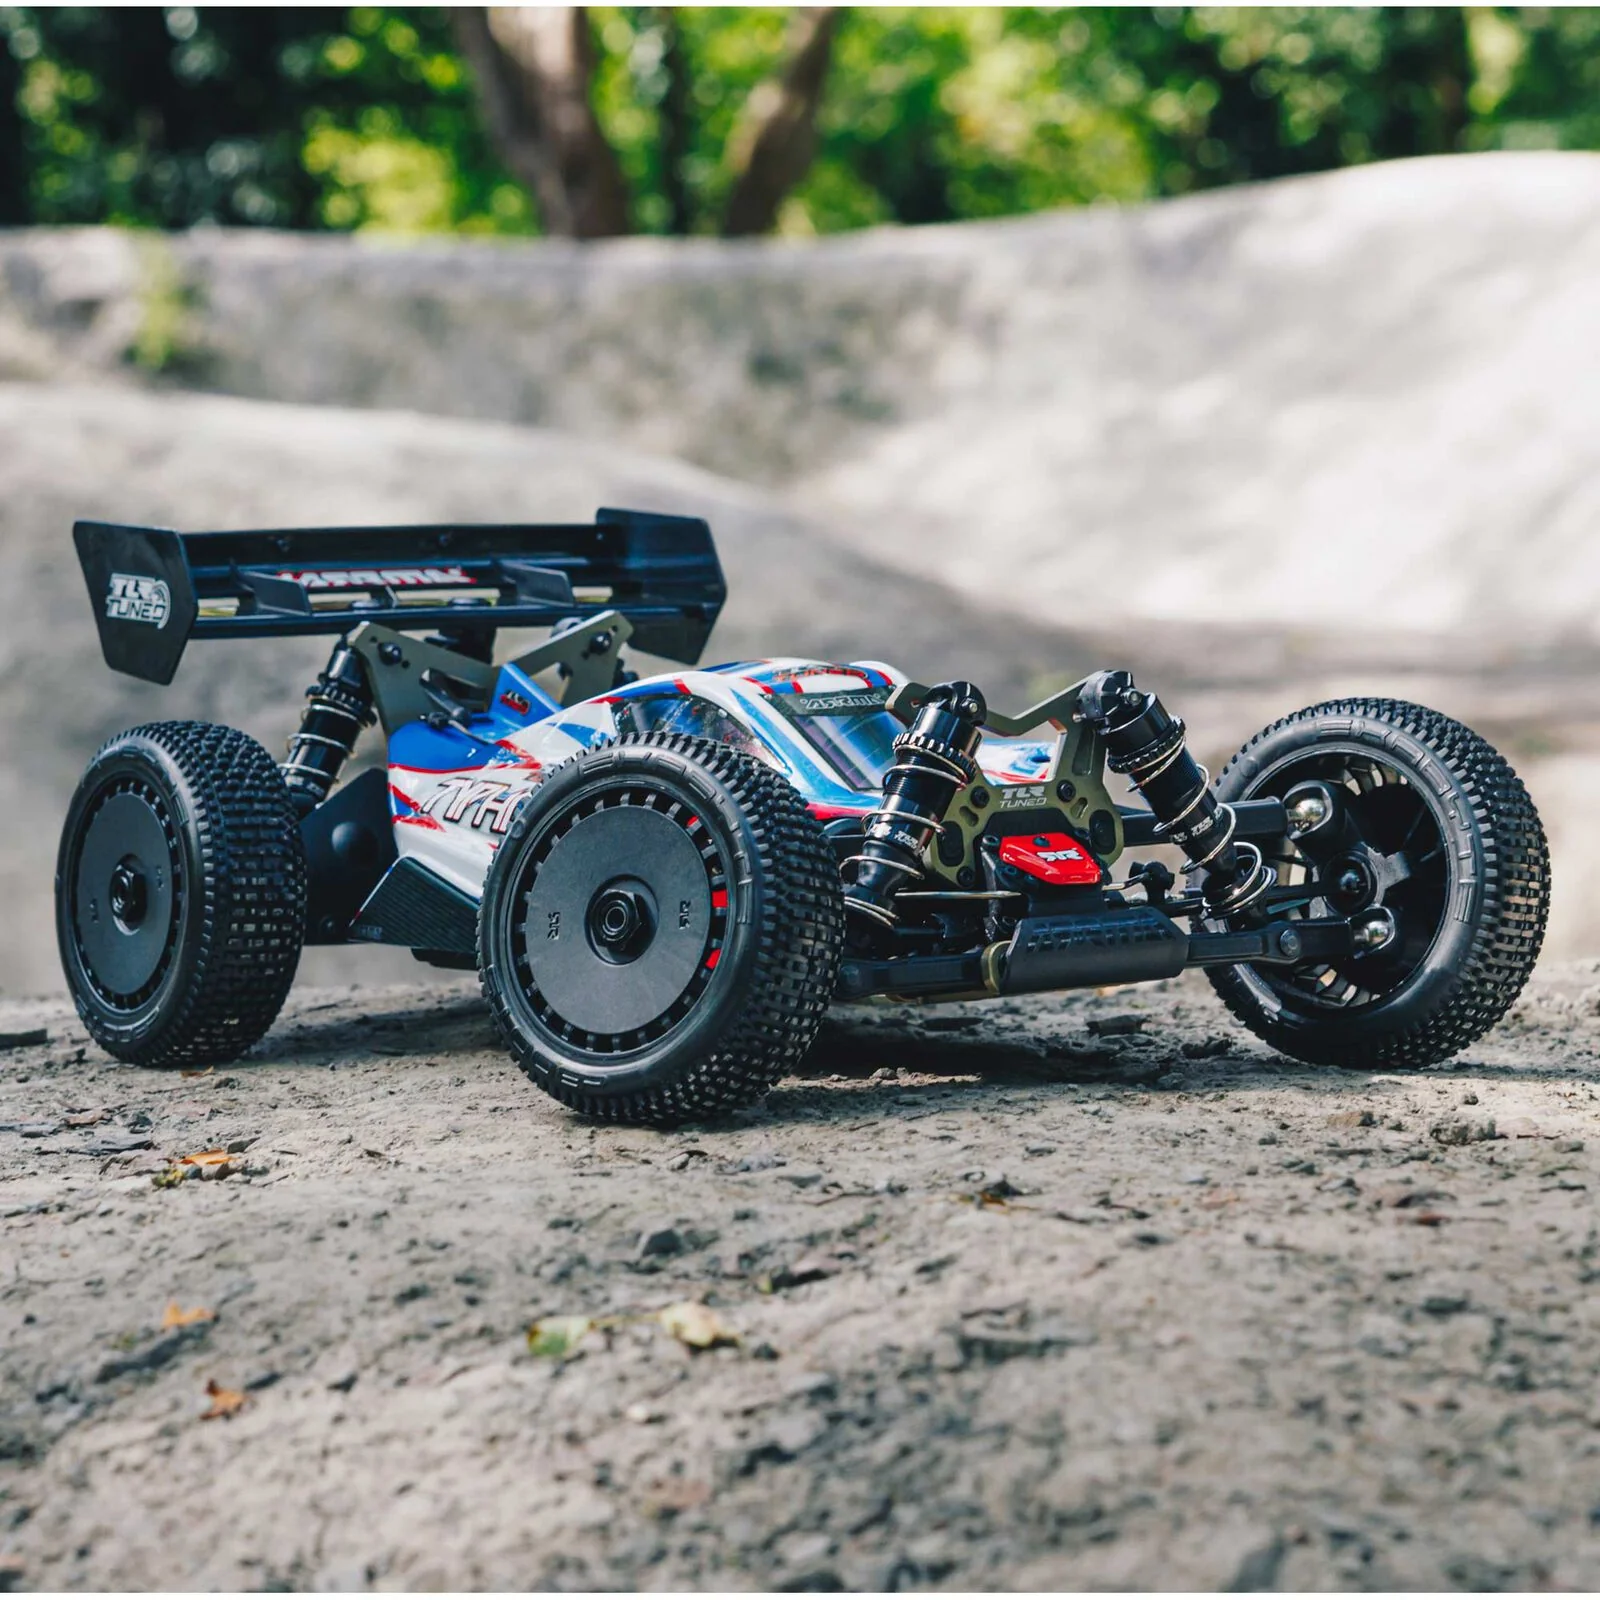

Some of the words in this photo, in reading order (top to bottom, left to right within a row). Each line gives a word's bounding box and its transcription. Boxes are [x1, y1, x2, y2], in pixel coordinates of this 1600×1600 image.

[105, 598, 167, 621] TUNED
[1002, 786, 1045, 799] TLR
[1000, 797, 1047, 808] TUNED
